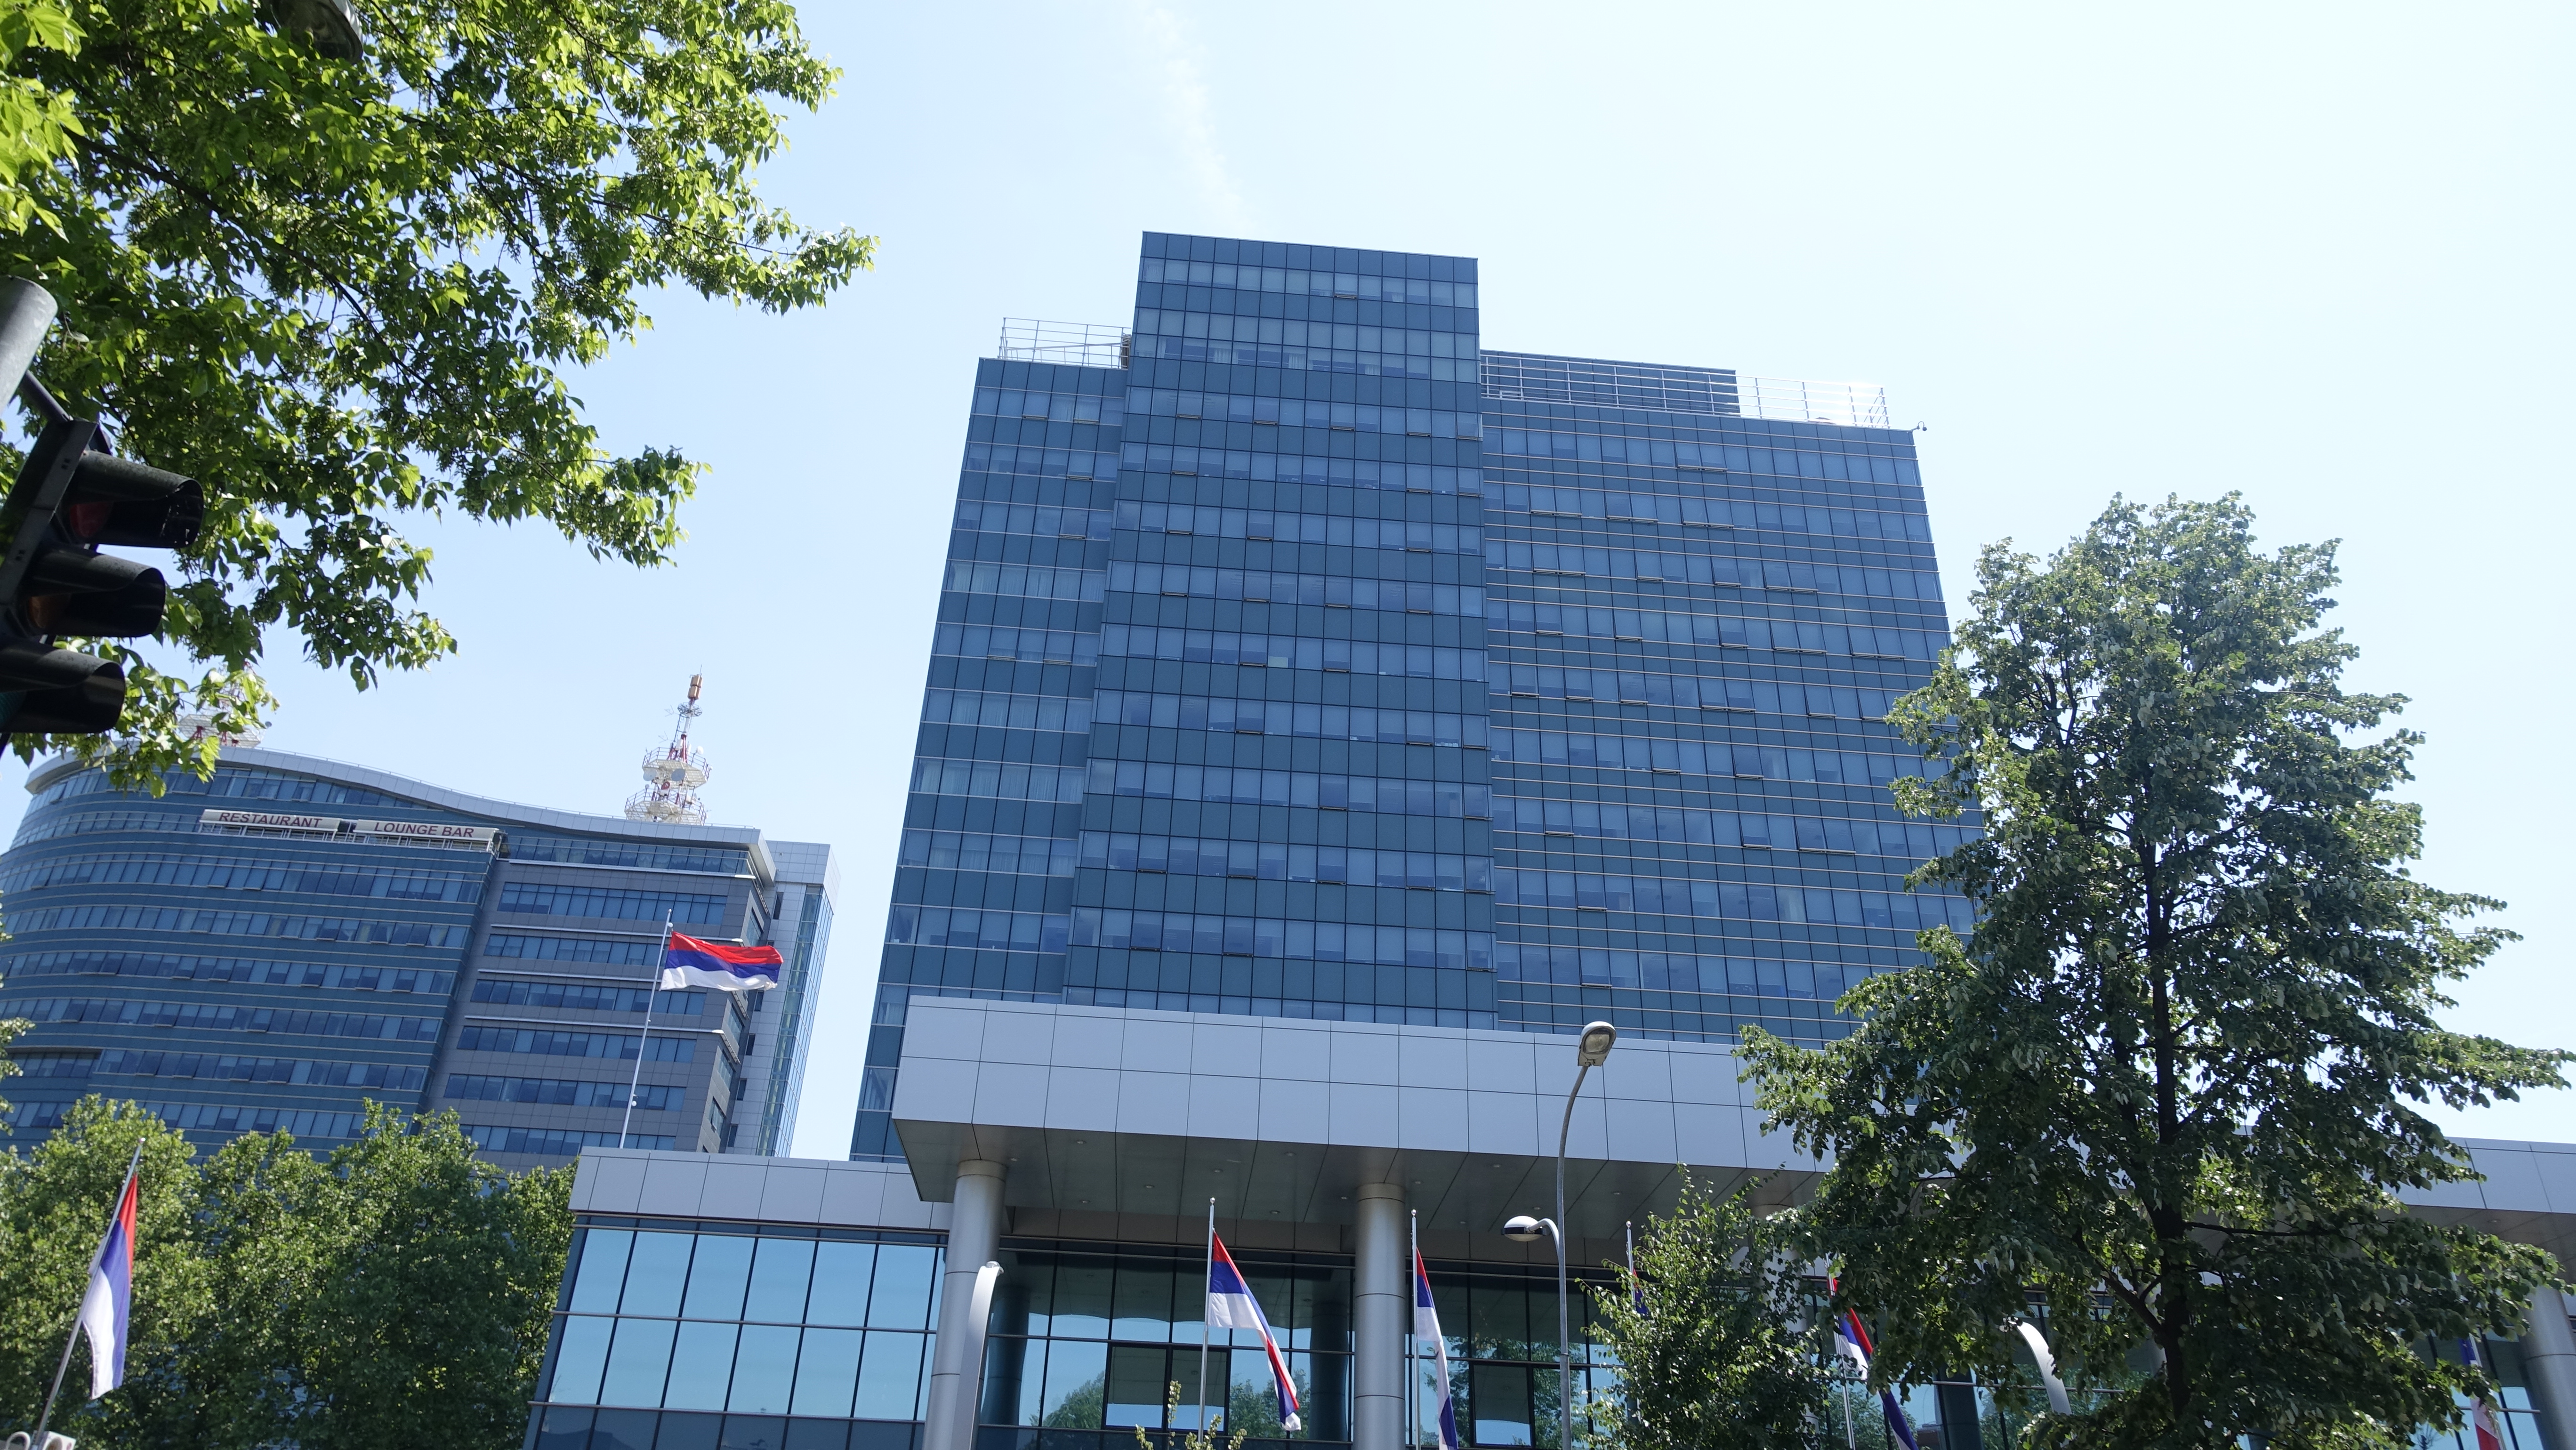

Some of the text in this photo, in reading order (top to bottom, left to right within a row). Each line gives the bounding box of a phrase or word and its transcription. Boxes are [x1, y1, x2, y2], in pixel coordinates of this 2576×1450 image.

[219, 812, 322, 828] RESTAURANT
[374, 822, 474, 838] LOUNGE BAR
